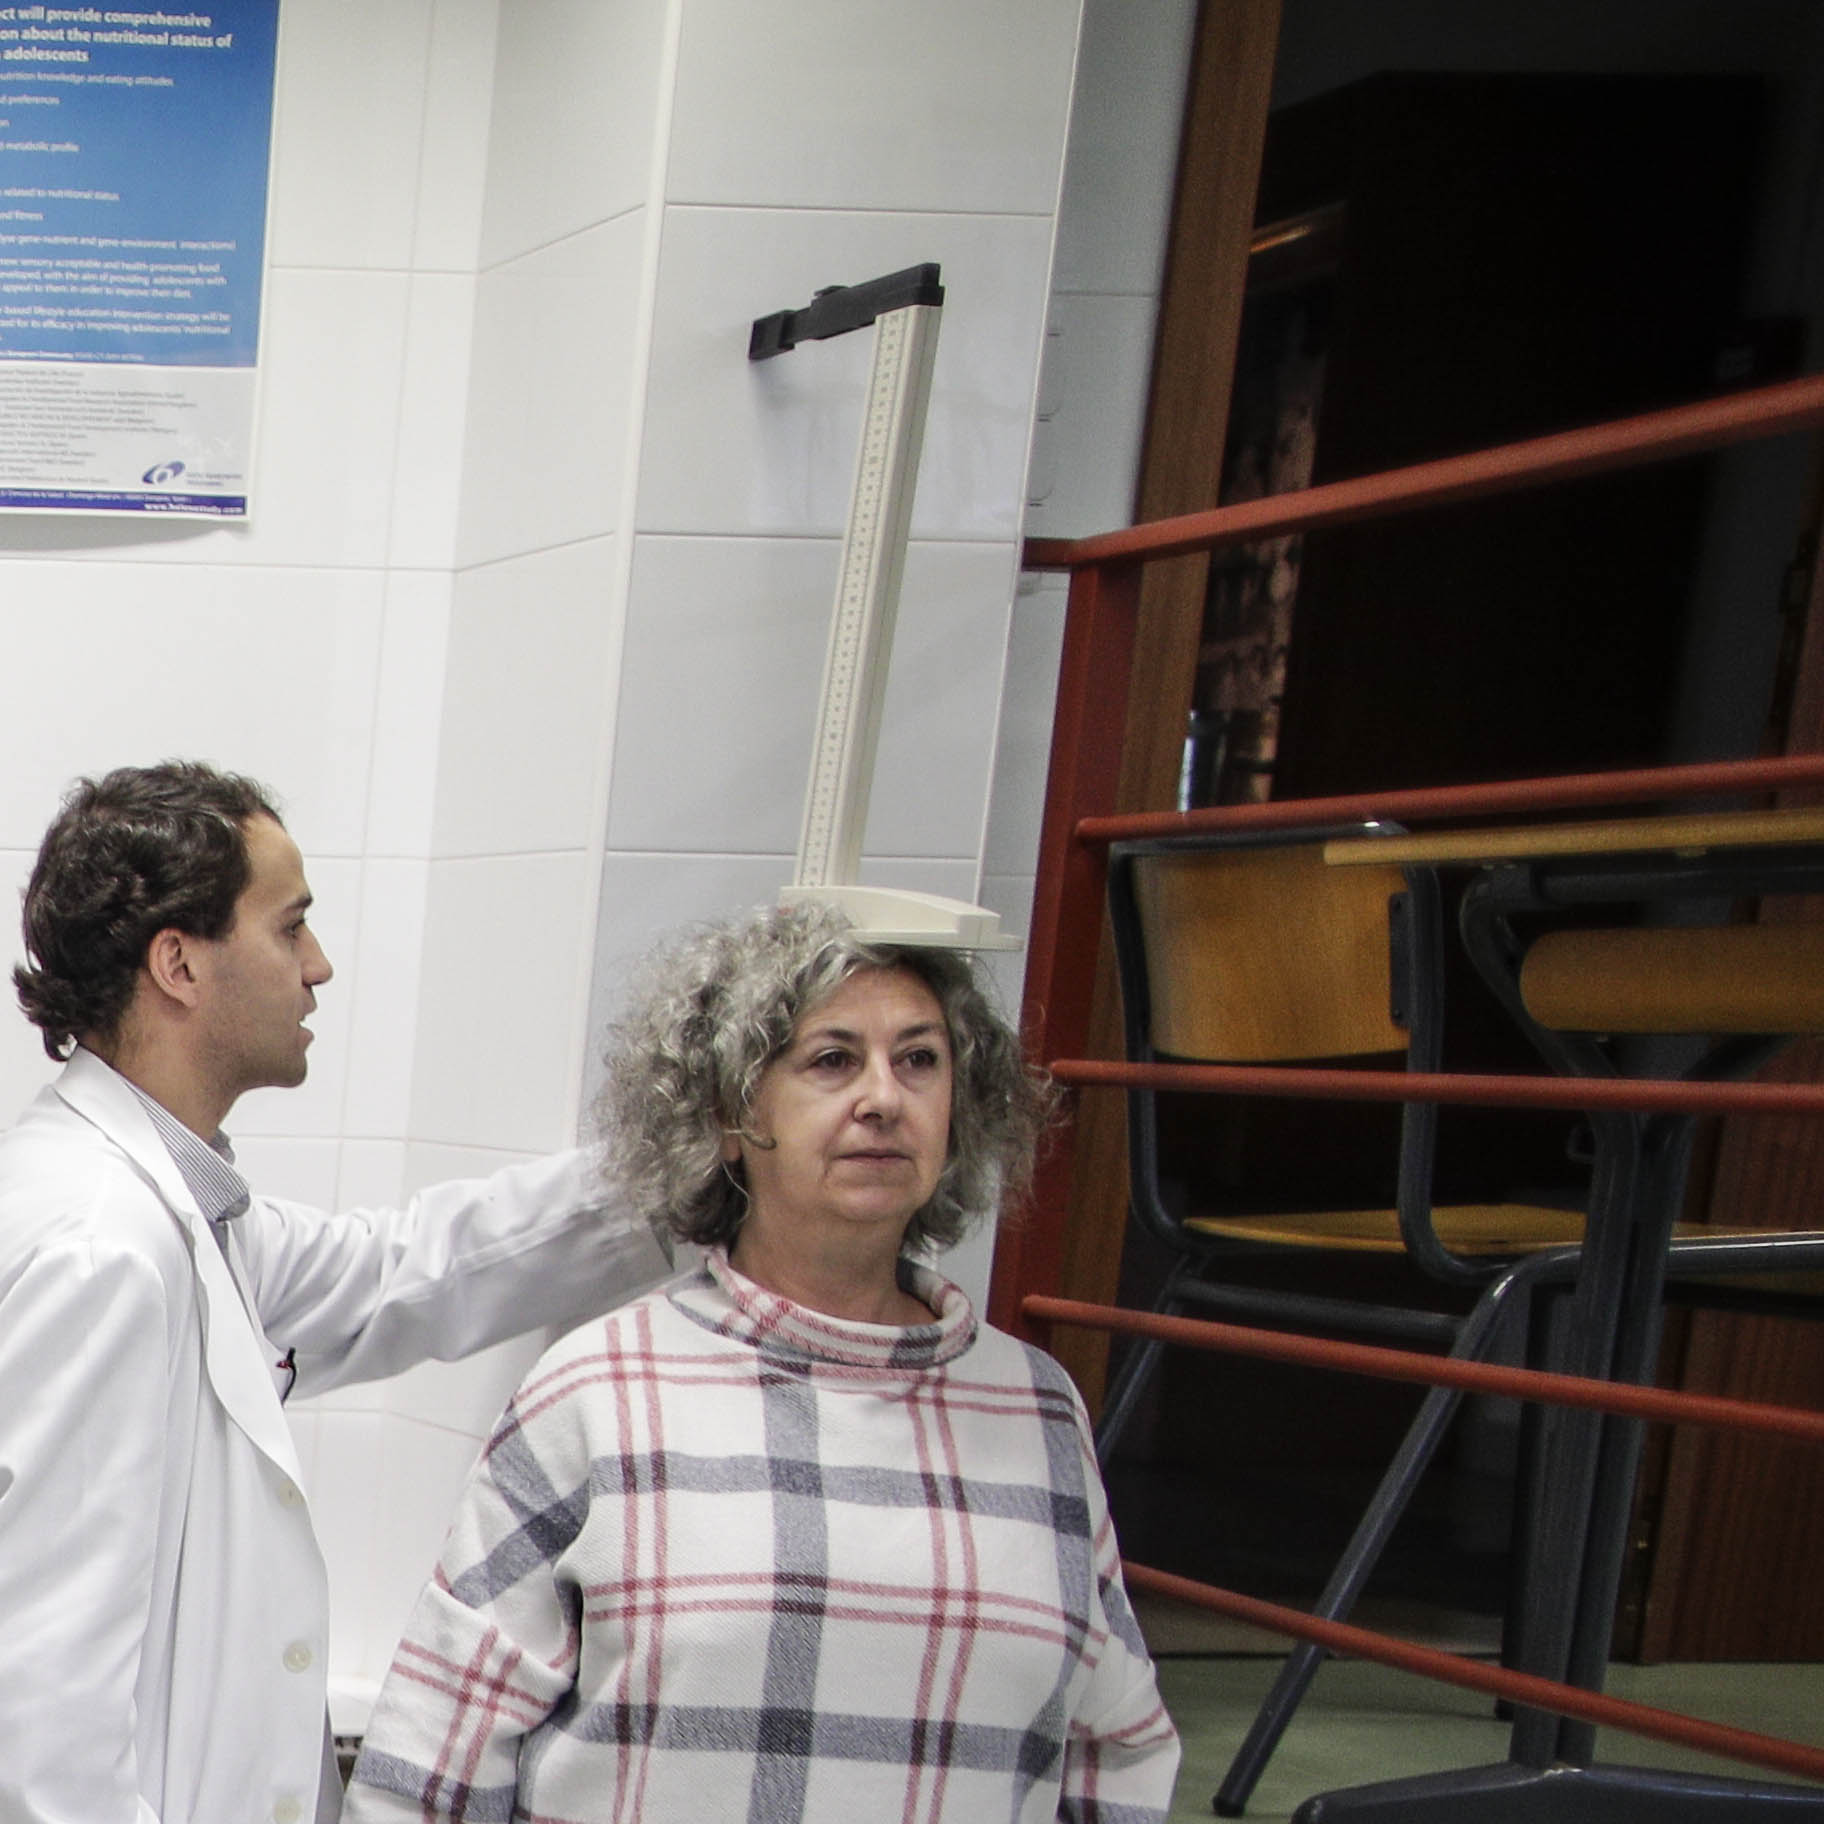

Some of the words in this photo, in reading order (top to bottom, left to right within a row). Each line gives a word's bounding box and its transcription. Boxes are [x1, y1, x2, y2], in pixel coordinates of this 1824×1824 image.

[17, 6, 45, 20] will
[46, 7, 102, 25] provide
[104, 11, 212, 28] comprehensive
[20, 26, 65, 42] about
[66, 27, 91, 43] the
[92, 30, 168, 46] nutritional
[170, 33, 215, 48] status
[215, 33, 233, 48] of
[3, 46, 90, 63] adolescents
